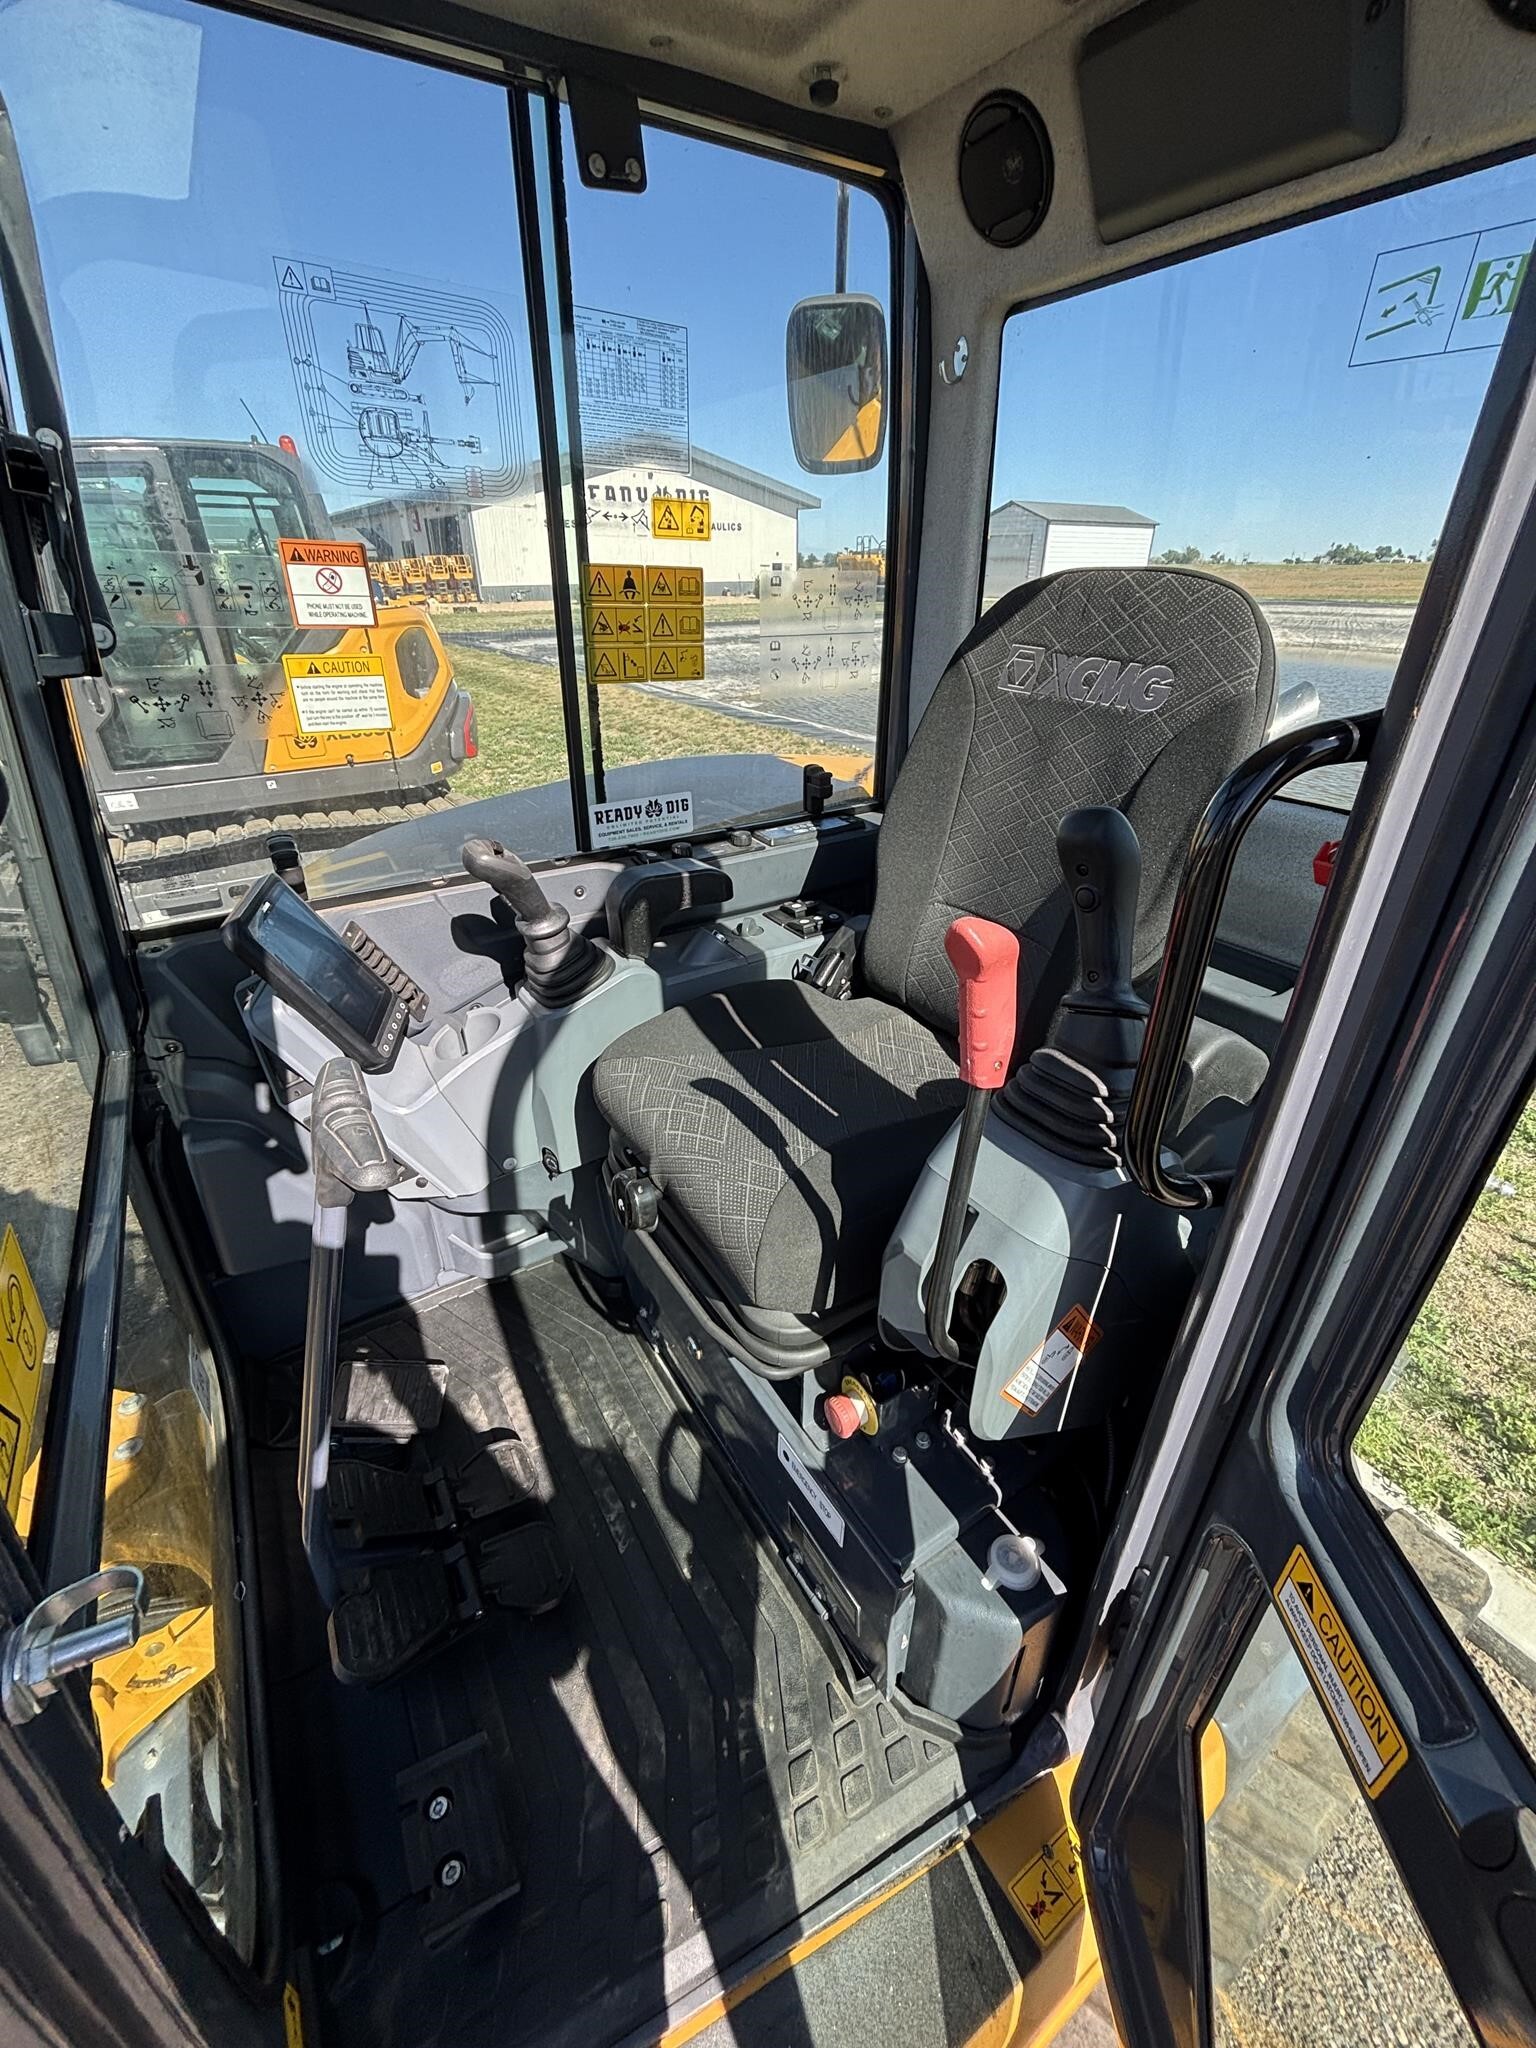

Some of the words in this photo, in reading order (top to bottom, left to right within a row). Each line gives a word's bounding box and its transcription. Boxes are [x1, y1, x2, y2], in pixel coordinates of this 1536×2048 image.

[711, 522, 742, 531] AULICS
[304, 548, 360, 563] WARNING
[306, 602, 322, 610] PHONE
[322, 602, 335, 610] MUST
[323, 660, 371, 674] CAUTION
[1035, 653, 1175, 712] XCMG
[594, 804, 642, 825] READY
[666, 798, 689, 814] DIG
[598, 829, 626, 838] EQUIPMENT
[668, 819, 688, 827] RENTALS
[1289, 1592, 1295, 1604] TO
[1294, 1604, 1307, 1628] AVOID
[1306, 1627, 1328, 1672] PERSONAL
[1285, 1599, 1301, 1629] ALWAYS
[1300, 1628, 1312, 1649] KEEP
[1311, 1649, 1324, 1675] DOOR
[1323, 1674, 1344, 1715] LATCHED
[1342, 1714, 1357, 1744] WHEN
[1319, 1613, 1388, 1745] CAUTION
